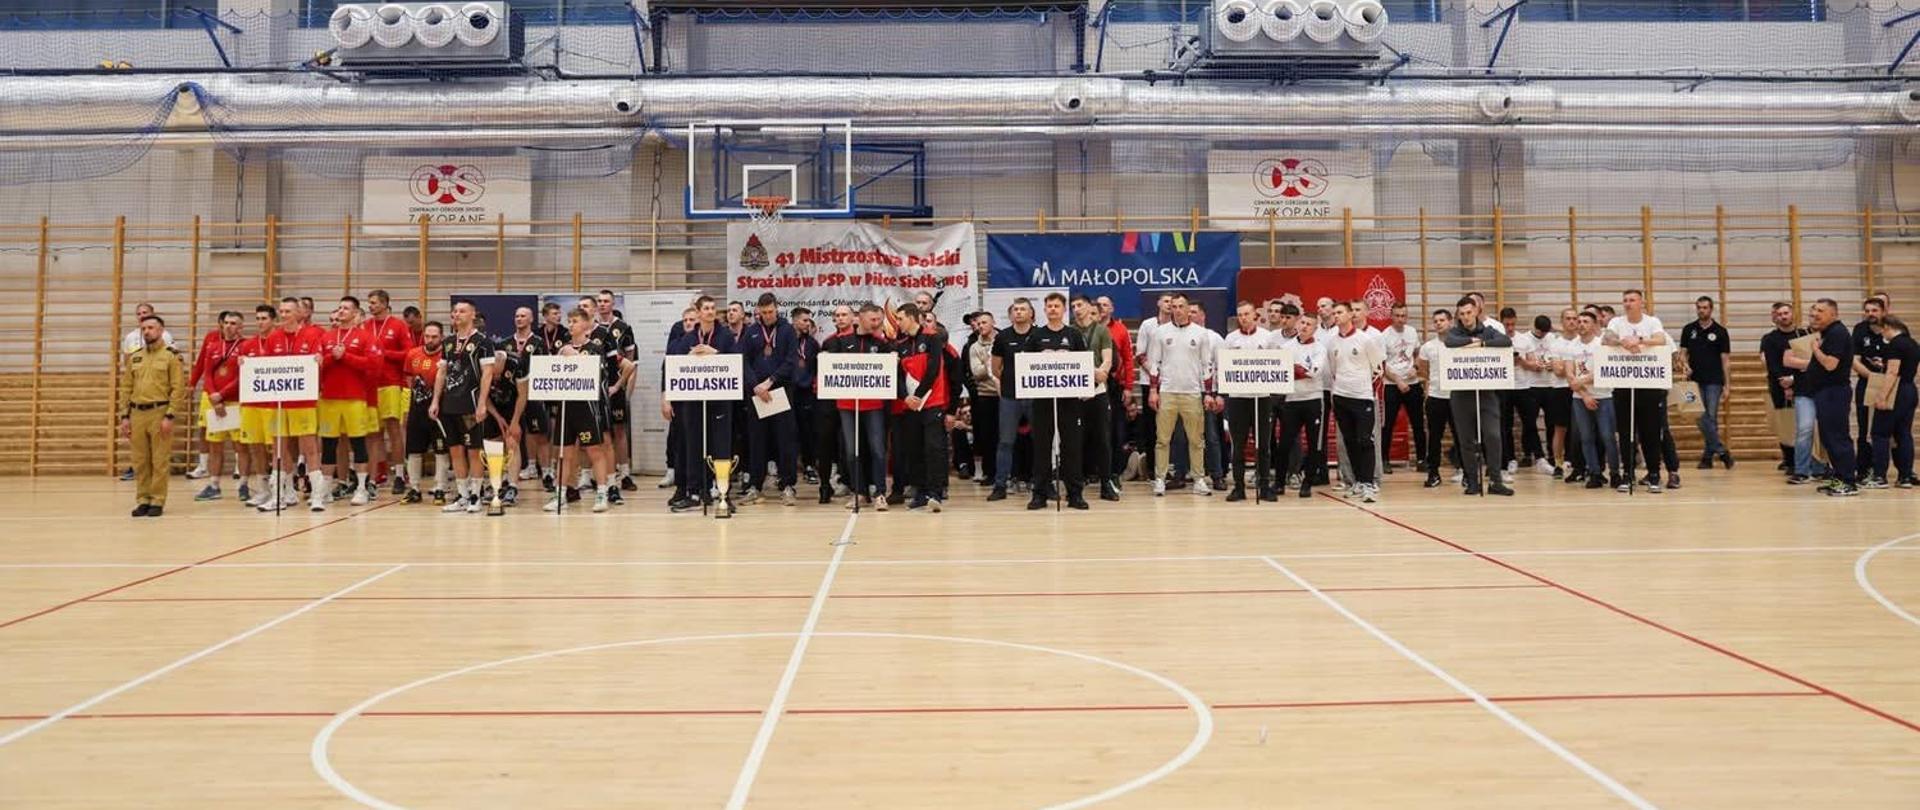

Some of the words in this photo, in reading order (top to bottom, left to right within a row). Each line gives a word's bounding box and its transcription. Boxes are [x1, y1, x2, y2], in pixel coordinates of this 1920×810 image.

[775, 252, 796, 268] 41
[799, 246, 903, 267] Mistrzostwa
[736, 273, 815, 289] Strażaków
[817, 272, 846, 287] PSP
[849, 275, 862, 286] w
[864, 271, 897, 287] Piłce
[1061, 267, 1200, 287] MAŁOPOLSKA
[551, 364, 562, 373] CS
[563, 364, 579, 373] PSP
[832, 361, 884, 371] WOJEWÓDZTWO
[1029, 361, 1081, 371] WOJEWÓDZTWO
[1600, 366, 1666, 379] MAŁOPOLSKIE
[824, 375, 892, 388] MAZOWIECKIE
[1021, 374, 1090, 389] LUBELSKIE
[1225, 370, 1290, 383] WIELKOPOLSKIE
[252, 376, 306, 394] ŚLĄSKIE
[533, 378, 596, 393] CZĘSTOCHOWA
[670, 377, 739, 391] PODLASKIE
